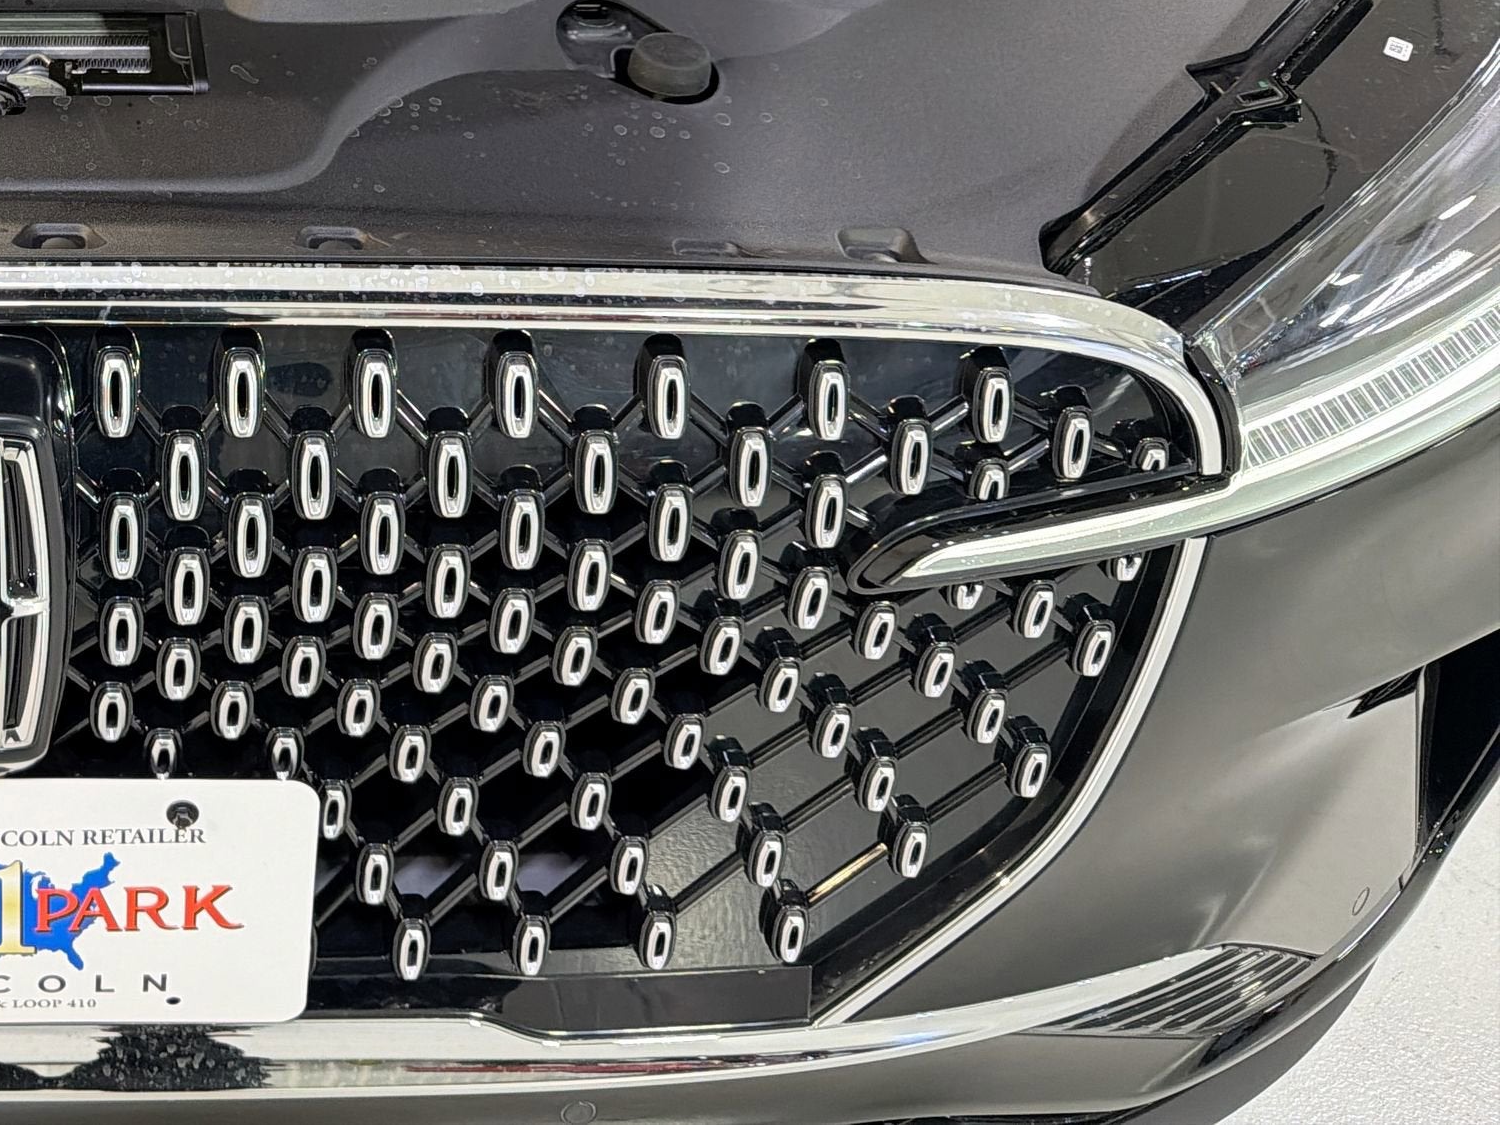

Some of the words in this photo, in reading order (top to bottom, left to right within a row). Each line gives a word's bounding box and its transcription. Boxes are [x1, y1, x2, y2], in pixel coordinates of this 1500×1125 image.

[81, 827, 207, 846] RETAILER
[34, 884, 245, 933] PARK
[12, 998, 63, 1010] LOOP
[66, 998, 98, 1010] 410
